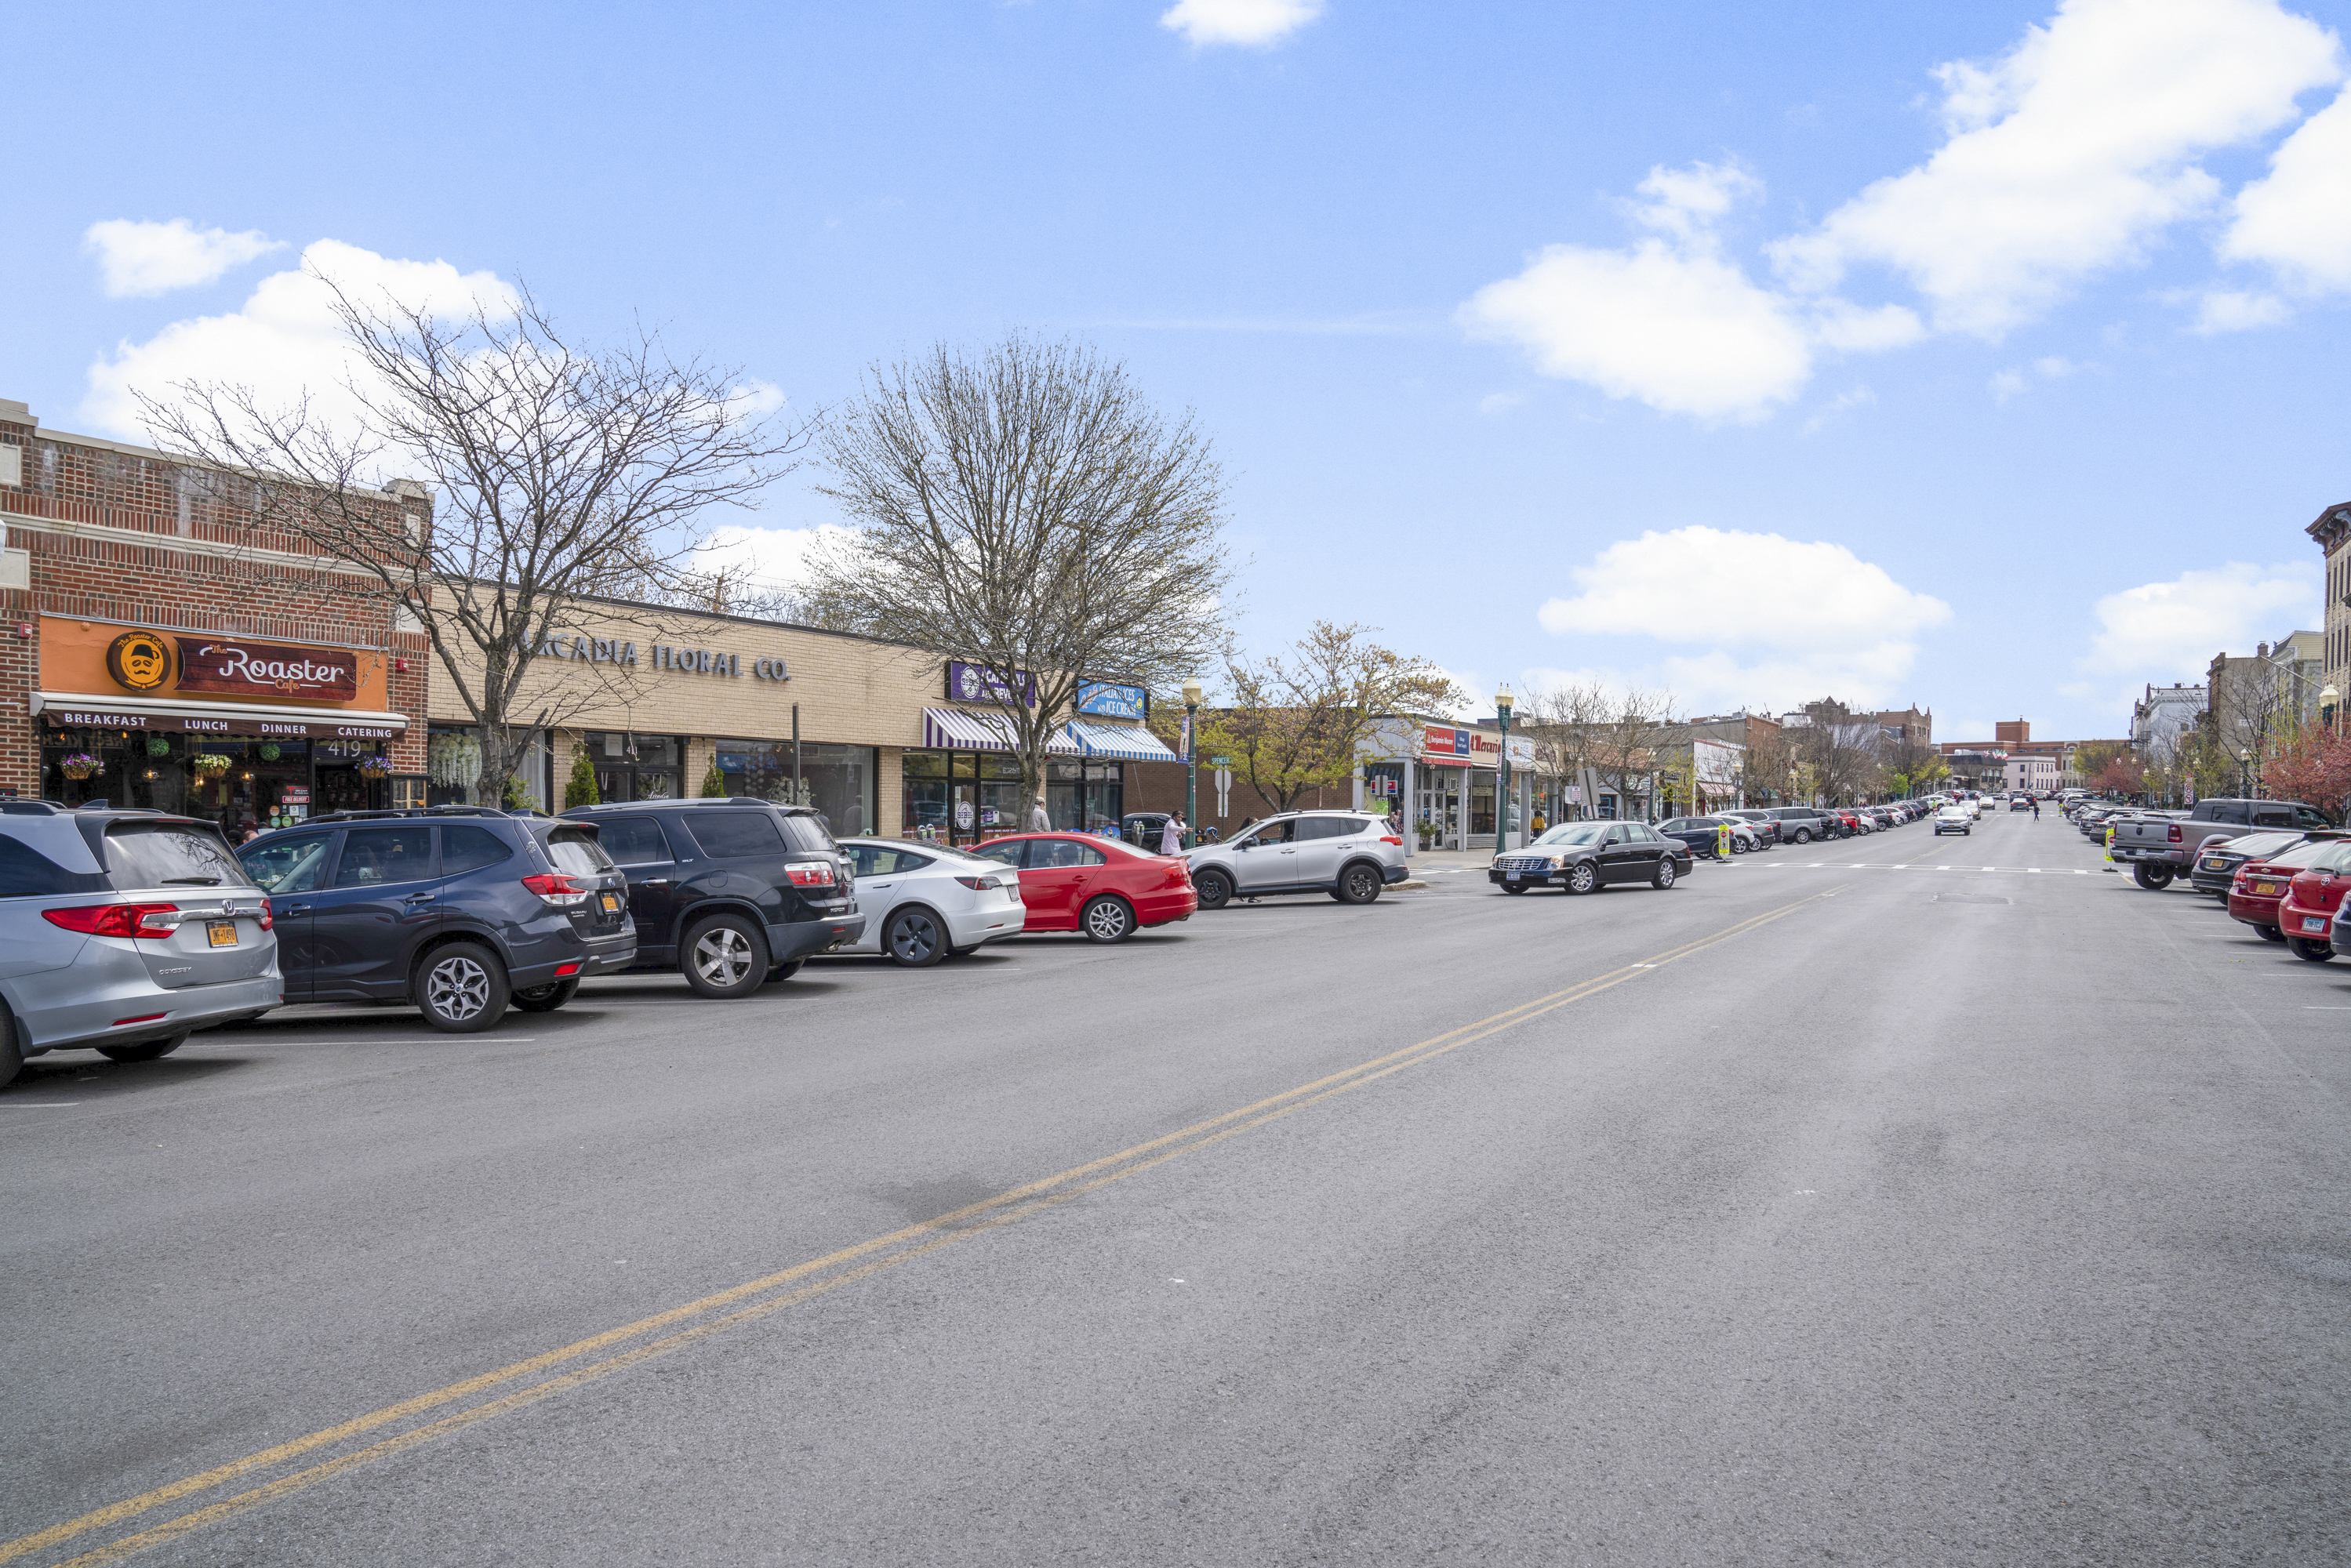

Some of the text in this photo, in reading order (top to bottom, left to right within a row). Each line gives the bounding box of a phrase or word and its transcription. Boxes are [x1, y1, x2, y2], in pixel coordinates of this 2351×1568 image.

[118, 639, 129, 648] The
[152, 637, 163, 649] Cafe
[209, 644, 227, 654] The
[218, 648, 344, 684] Roaster
[654, 645, 743, 676] FLORAL
[754, 658, 792, 681] CO.
[275, 679, 300, 693] Cafe
[1099, 684, 1135, 702] ITALIAN ICES
[1097, 701, 1136, 716] AND ICE CREAM
[64, 713, 392, 738] BREAKFAST LUNCH DINNER CATERING
[328, 739, 362, 757] 419
[1431, 735, 1453, 746] Benjamin Moore
[1474, 735, 1501, 753] Mercurio
